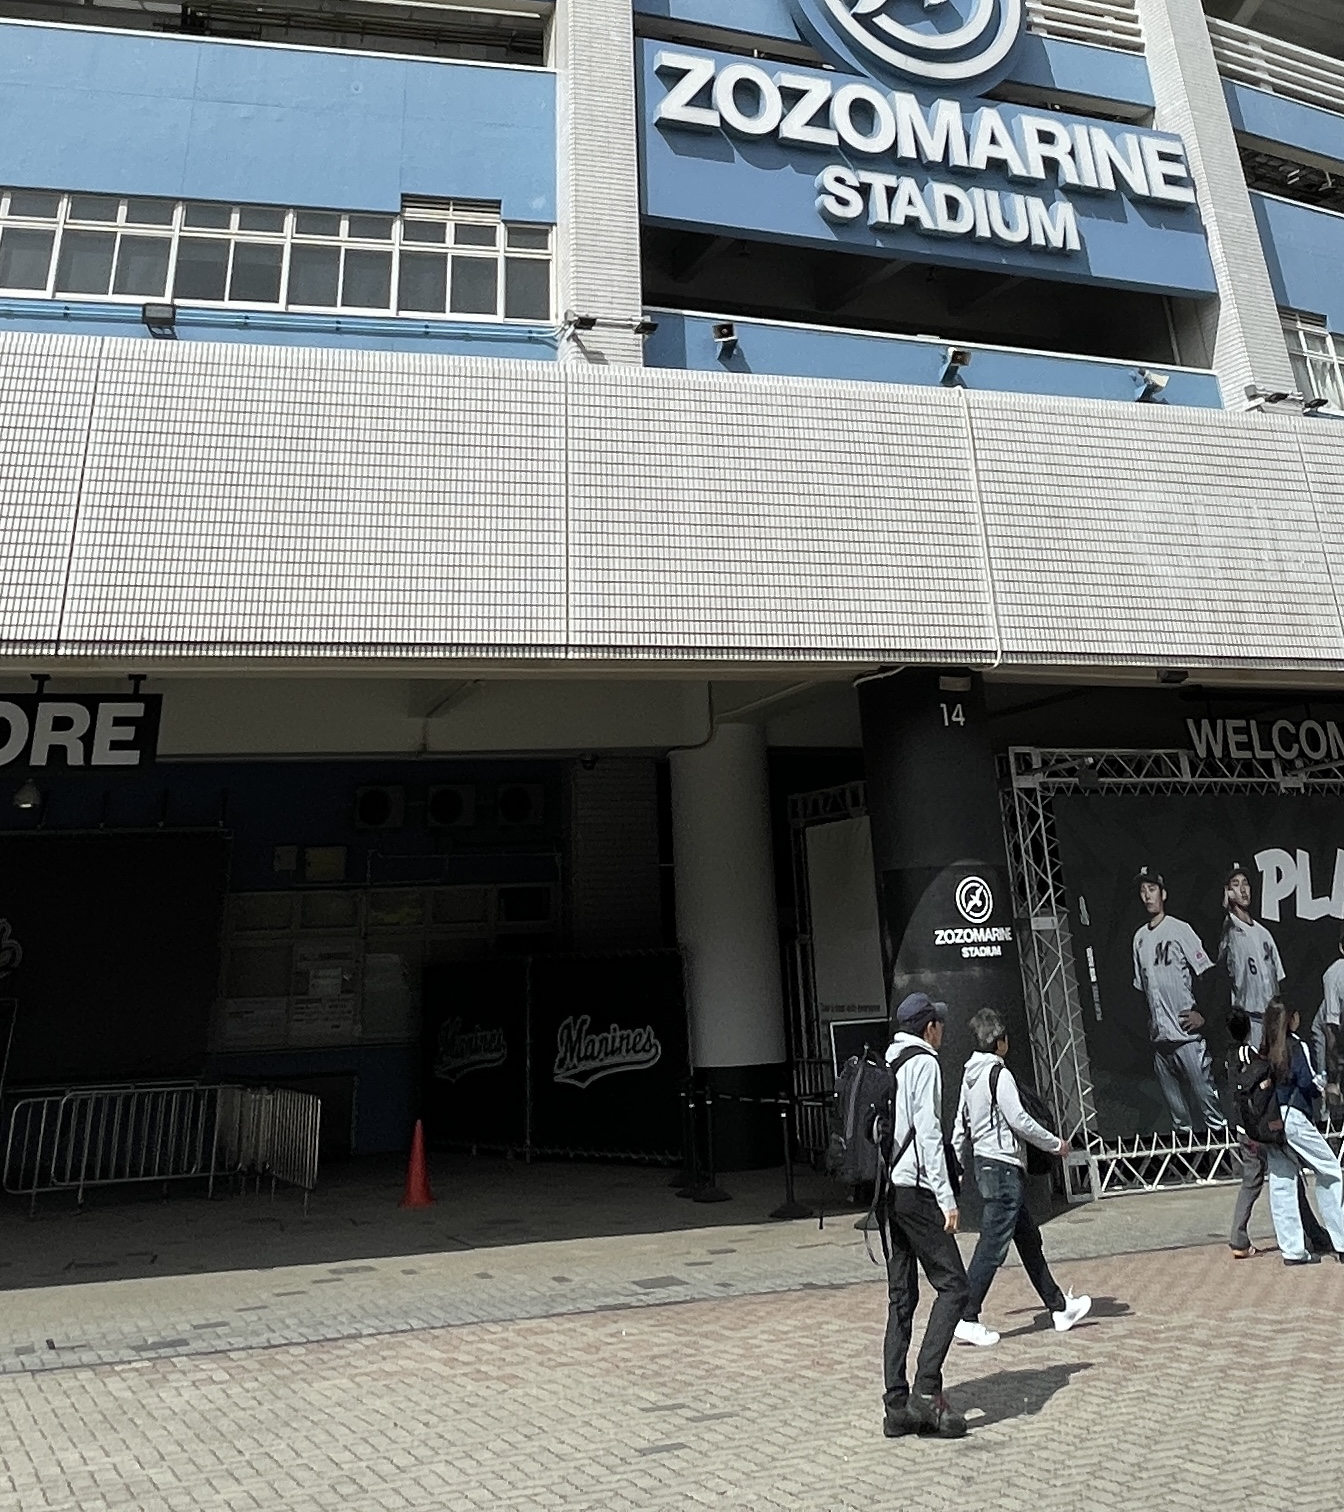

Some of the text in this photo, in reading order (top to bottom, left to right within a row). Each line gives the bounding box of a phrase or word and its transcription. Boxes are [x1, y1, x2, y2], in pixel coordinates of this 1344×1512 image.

[656, 52, 1197, 204] ZOZOMARINE
[815, 164, 1081, 252] STADIUM
[940, 703, 965, 727] 14
[934, 926, 1013, 945] ZOZOMARINE
[961, 945, 1002, 958] STADIUM
[1247, 957, 1258, 975] 6
[553, 1014, 662, 1088] Marines
